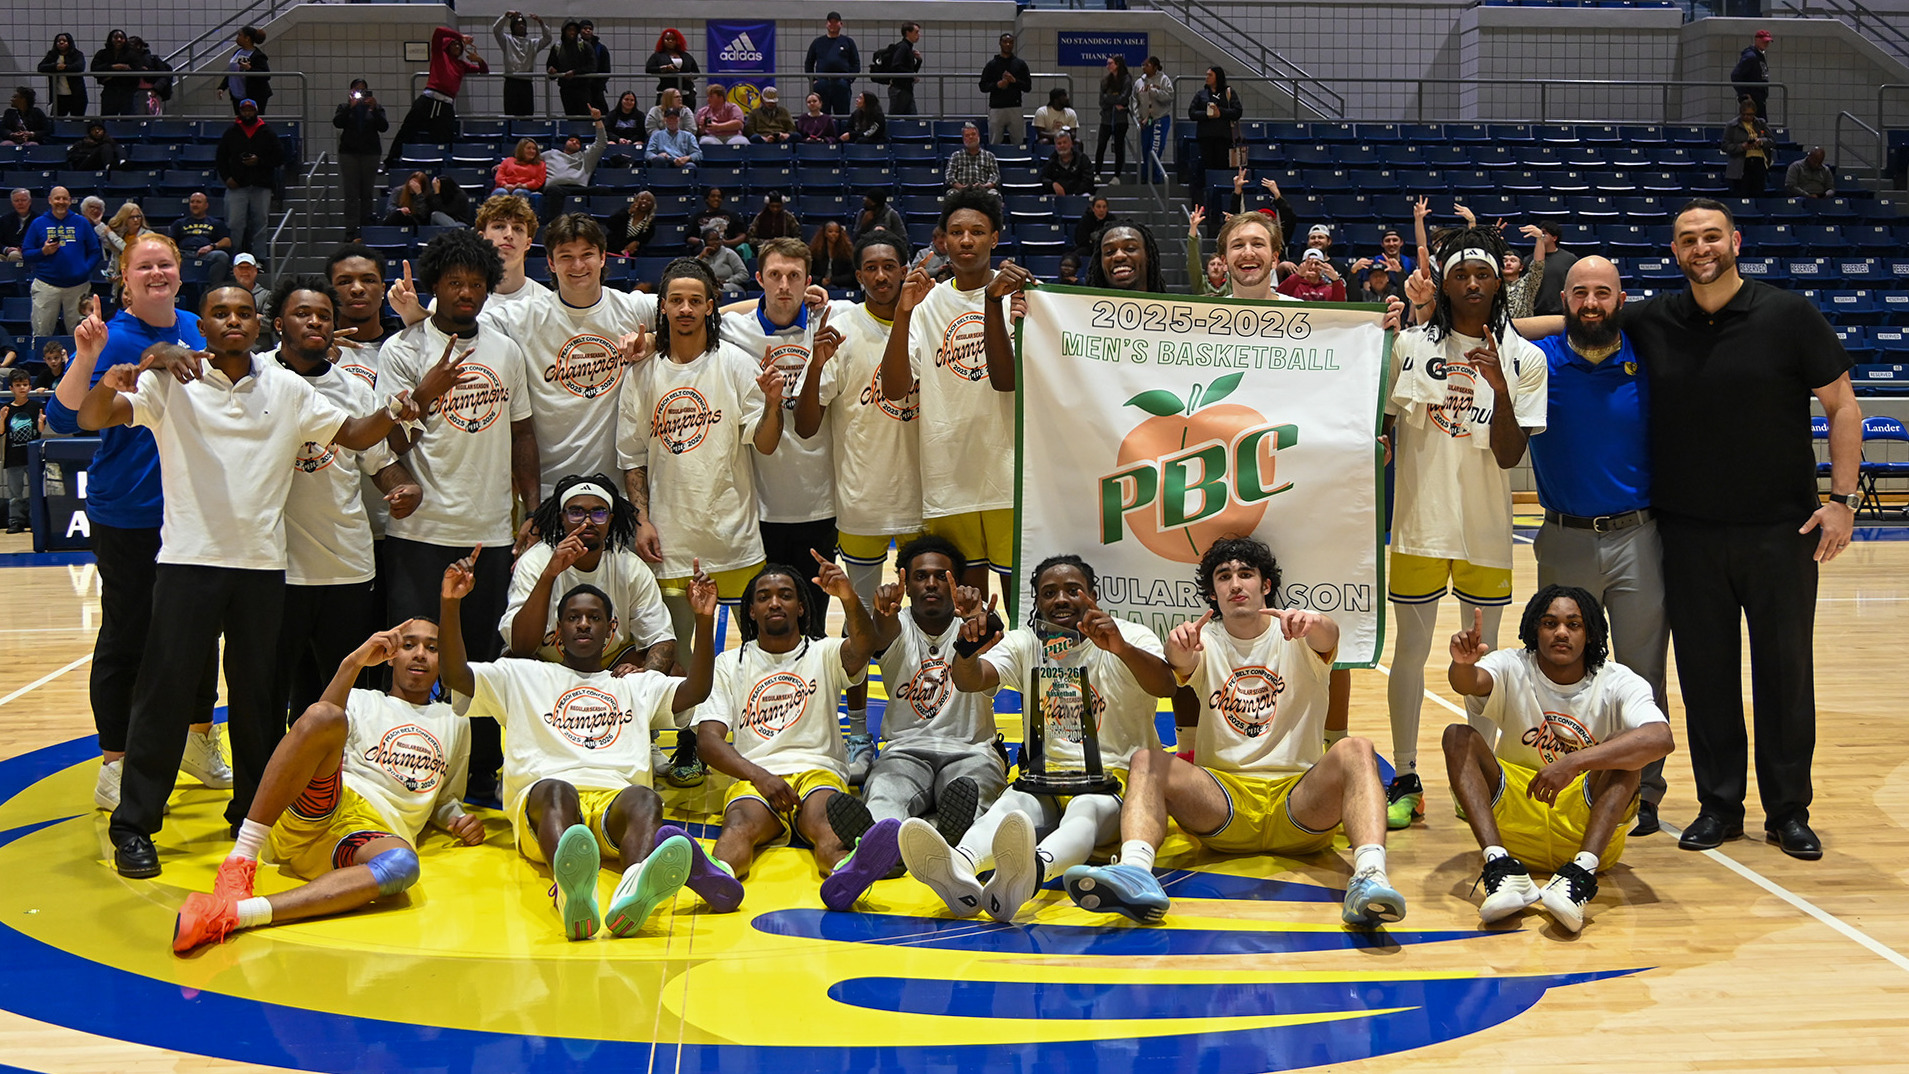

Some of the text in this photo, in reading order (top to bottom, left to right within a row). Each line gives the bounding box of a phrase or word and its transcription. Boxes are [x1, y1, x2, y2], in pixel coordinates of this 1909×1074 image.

[720, 50, 763, 61] adidas
[1152, 124, 1161, 152] LANDE
[1739, 263, 1767, 273] RESERVED
[1790, 263, 1818, 273] RESERVED
[1842, 264, 1869, 273] RESERVED
[946, 322, 957, 340] PEACH
[957, 316, 969, 324] BELT
[1091, 300, 1312, 340] 2025-2026
[561, 336, 618, 358] PEACH BELT CONFERENCE
[936, 340, 985, 367] Champ
[1061, 331, 1340, 370] MEN’S BASKETBALL
[356, 368, 376, 380] CONFER
[469, 366, 499, 387] CONFERENCE
[953, 364, 968, 376] 2025
[566, 381, 582, 393] 2025
[600, 376, 615, 390] 2026
[428, 388, 509, 415] Champions
[658, 398, 670, 414] PEACH
[883, 404, 899, 416] 2025
[449, 414, 465, 426] 2025
[482, 411, 496, 425] 2026
[1811, 424, 1829, 432] and
[1865, 424, 1900, 432] Lander
[1098, 424, 1298, 545] PBC
[1277, 583, 1370, 612] SON
[1044, 638, 1073, 657] PBC
[1040, 667, 1079, 679] 2025-26
[751, 683, 764, 702] PEACH
[764, 677, 777, 686] BELT
[558, 695, 572, 709] PEACH
[586, 690, 617, 710] CONFERENCE
[938, 690, 949, 706] 2026
[1209, 676, 1285, 720] Champios
[544, 709, 633, 733] Champions
[1228, 714, 1245, 729] 2025
[385, 730, 400, 742] PEACH
[564, 731, 581, 742] 2025
[599, 734, 614, 745] 2026
[758, 727, 774, 737] 2025
[1558, 718, 1592, 745] CONFERENCE
[396, 742, 416, 750] REGULAR
[1544, 753, 1554, 763] 20
[421, 779, 436, 789] 2026
